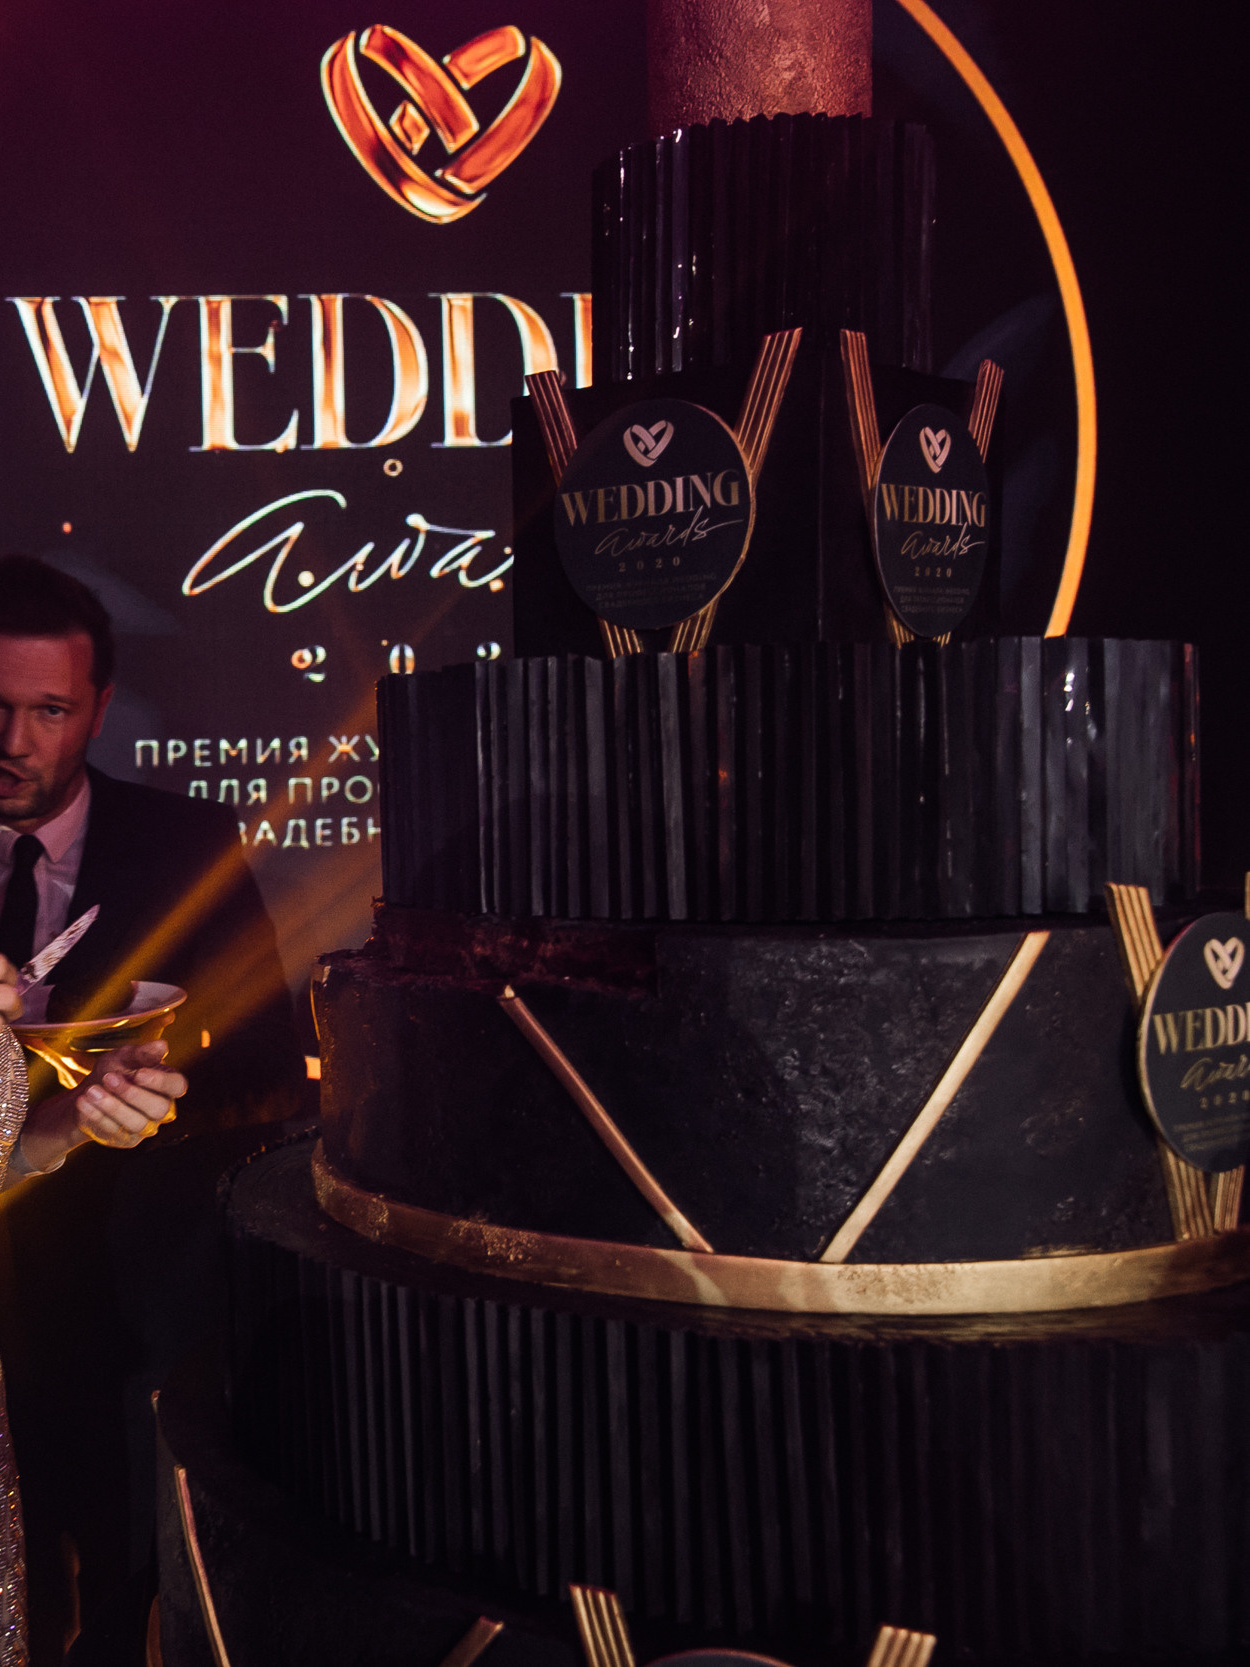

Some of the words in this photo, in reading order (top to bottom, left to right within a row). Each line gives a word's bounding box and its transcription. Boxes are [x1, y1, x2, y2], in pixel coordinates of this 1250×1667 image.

[561, 469, 740, 527] WEDDING
[881, 483, 986, 527] WEDDING
[135, 737, 309, 768] ПРЕМИЯ
